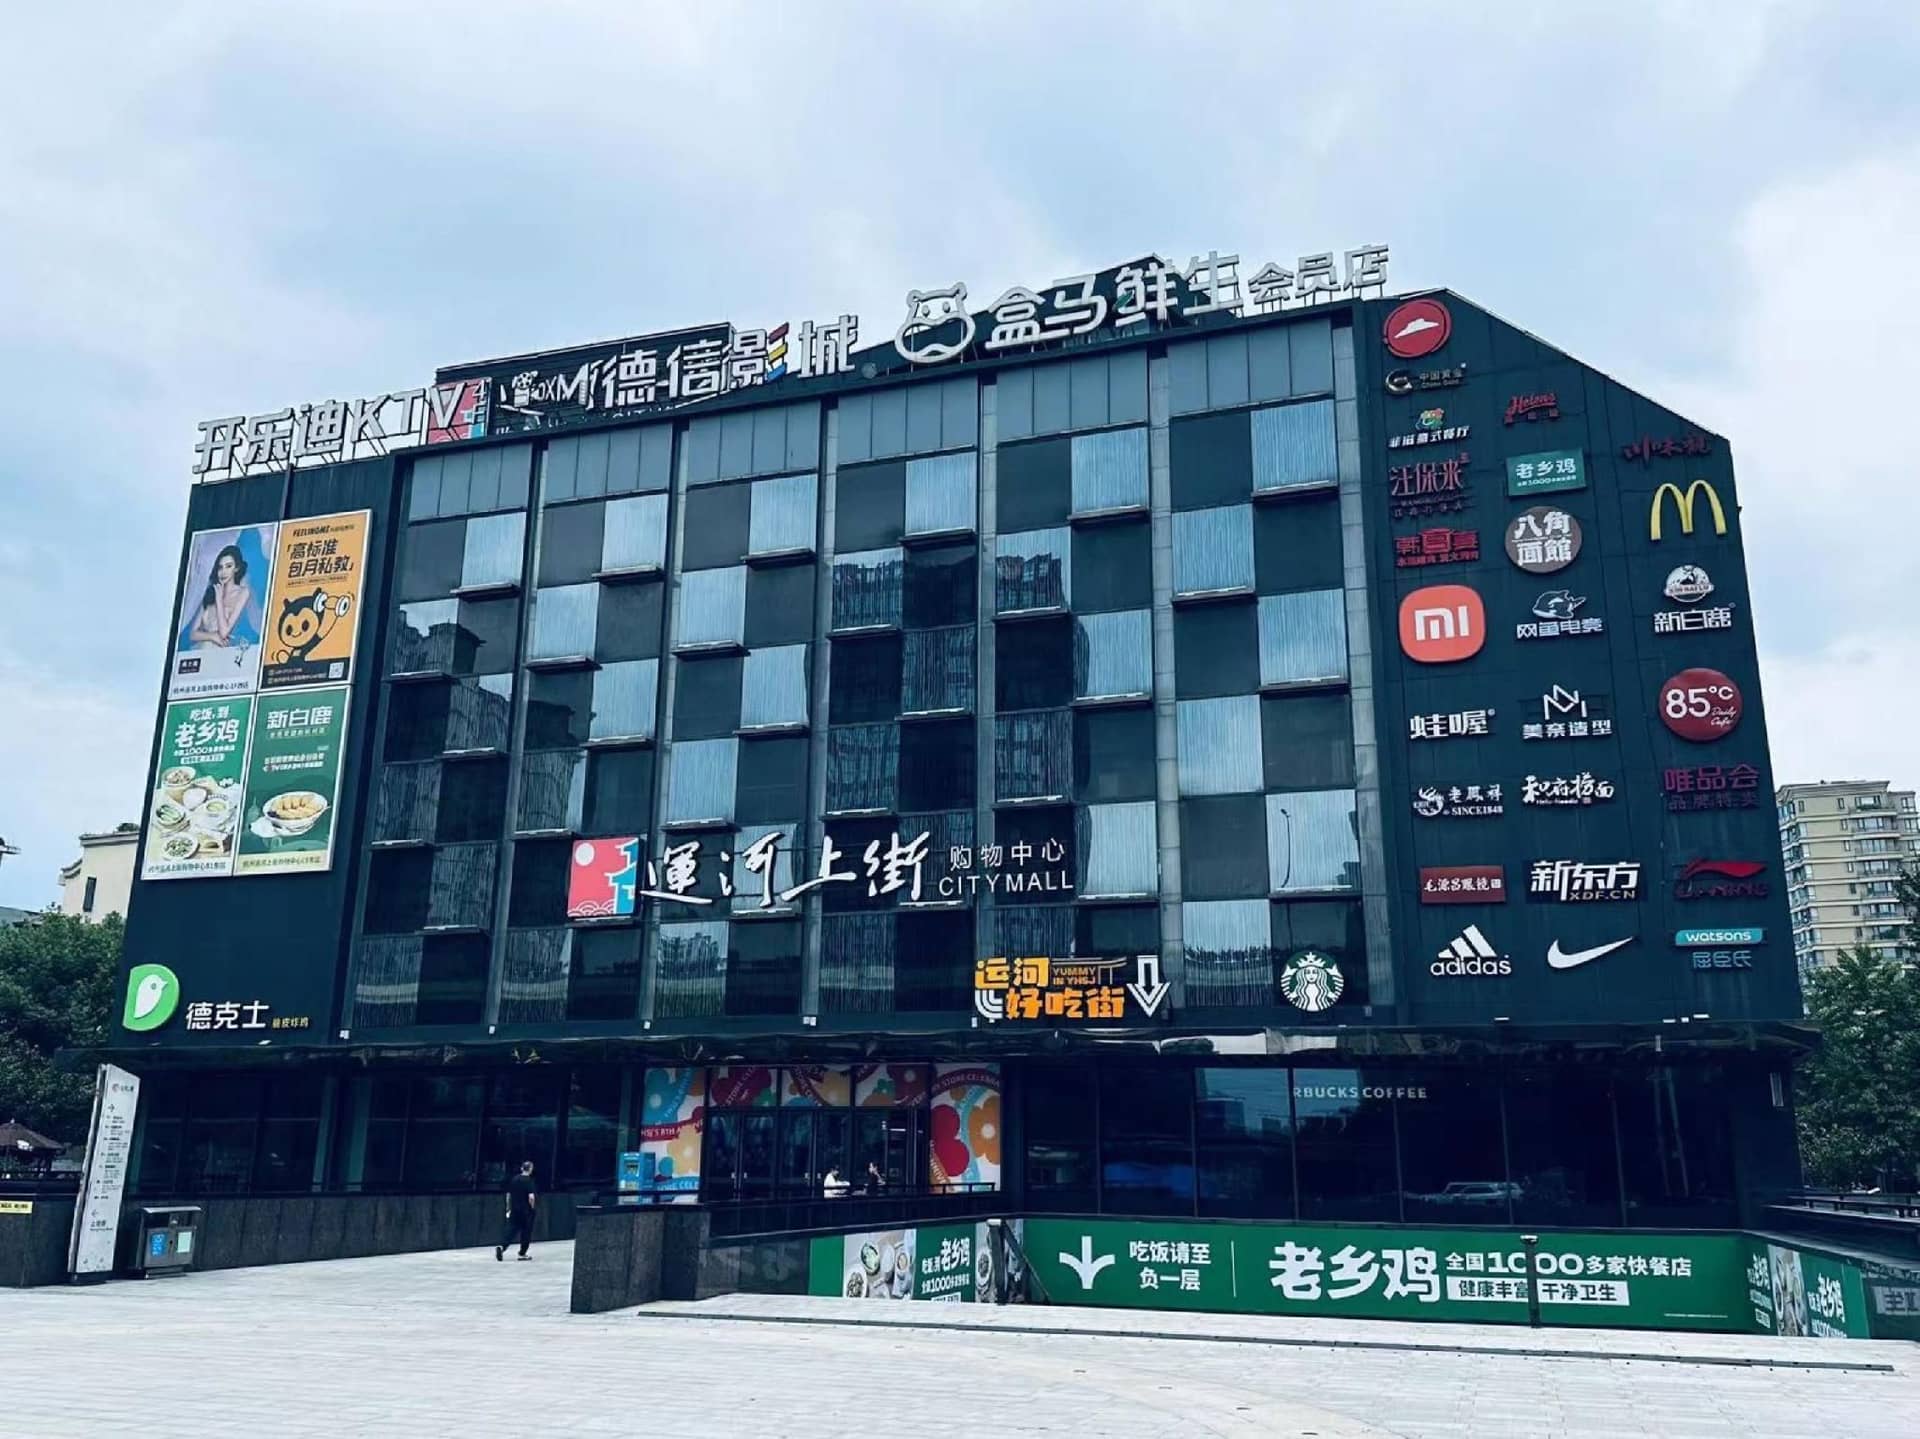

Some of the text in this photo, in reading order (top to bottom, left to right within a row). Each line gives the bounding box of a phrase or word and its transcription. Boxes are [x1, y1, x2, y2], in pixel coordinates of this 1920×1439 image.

[985, 245, 1389, 350] 盒马鲜生 会员店
[597, 315, 858, 409] 德信影城
[193, 382, 467, 474] 开乐迪KTV
[1515, 458, 1576, 479] 老乡鸡
[1514, 511, 1571, 538] 八角
[1654, 607, 1732, 632] 新白鹿
[266, 706, 333, 729] 新白鹿
[1410, 710, 1488, 739] 蛙喔
[1522, 719, 1612, 740] 美奈造型
[175, 719, 240, 748] 老乡鸡
[1664, 763, 1760, 793] 唯品会
[950, 838, 1065, 871] 购物中心
[1531, 860, 1640, 901] 新东方
[1569, 889, 1636, 901] XDF.CN
[1685, 931, 1752, 942] watsons
[1053, 967, 1096, 976] YUMMY
[1431, 957, 1511, 976] adidas
[1692, 950, 1752, 968] 屈臣氏
[975, 956, 1050, 989] 运河
[186, 1000, 270, 1030] 德克士
[1005, 986, 1125, 1019] 好吃街
[1362, 1086, 1427, 1099] COFFEE
[941, 1237, 970, 1271] 老乡鸡
[1129, 1240, 1212, 1265] 吃饭请至
[1446, 1252, 1692, 1277] 全国1000多家快餐店
[1139, 1266, 1201, 1291] 负一层
[1269, 1241, 1440, 1302] 老乡鸡
[1459, 1279, 1617, 1301] 健康丰富 干净卫生
